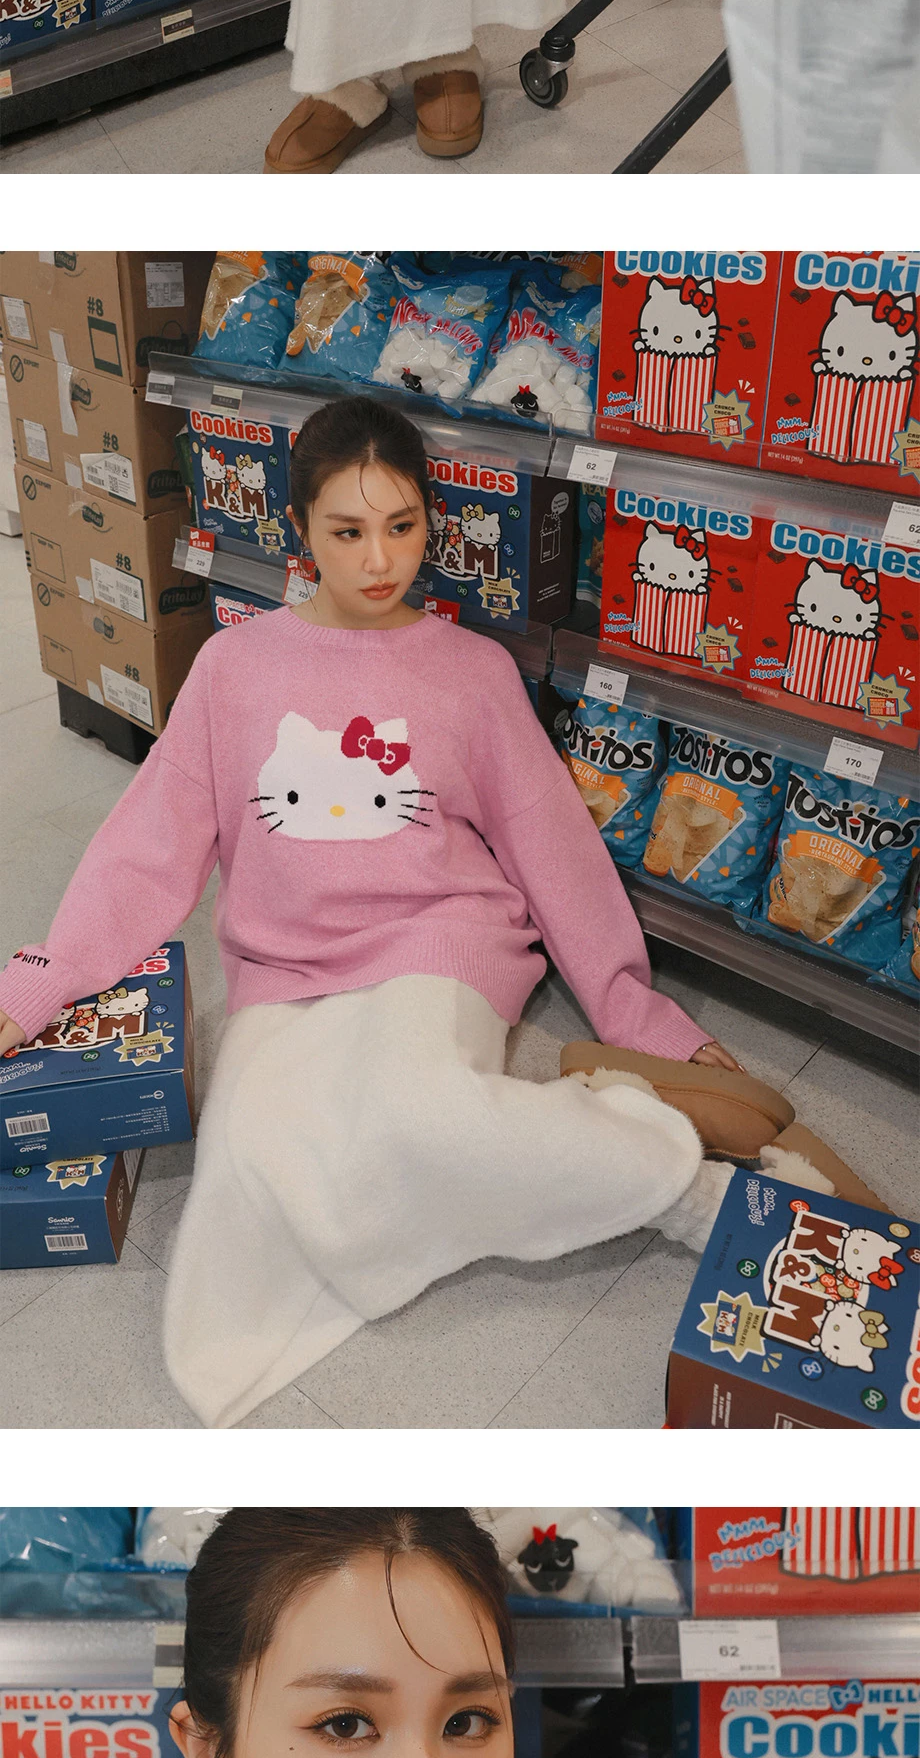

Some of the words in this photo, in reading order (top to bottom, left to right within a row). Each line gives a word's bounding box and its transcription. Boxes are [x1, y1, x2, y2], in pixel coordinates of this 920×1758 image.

[617, 251, 762, 281] Cookies
[191, 411, 272, 444] Cookies
[586, 462, 597, 471] 62
[427, 460, 515, 493] ookies
[206, 479, 268, 517] K&M
[617, 489, 750, 537] Cookies
[599, 681, 613, 691] 160
[844, 757, 862, 769] 170
[809, 834, 864, 871] ORIGINAL
[22, 954, 50, 968] KITTY
[719, 1645, 740, 1658] 62
[5, 1695, 73, 1710] HELLO
[81, 1695, 152, 1710] KITTY
[727, 1689, 758, 1707] AIR
[763, 1688, 829, 1707] SPACE
